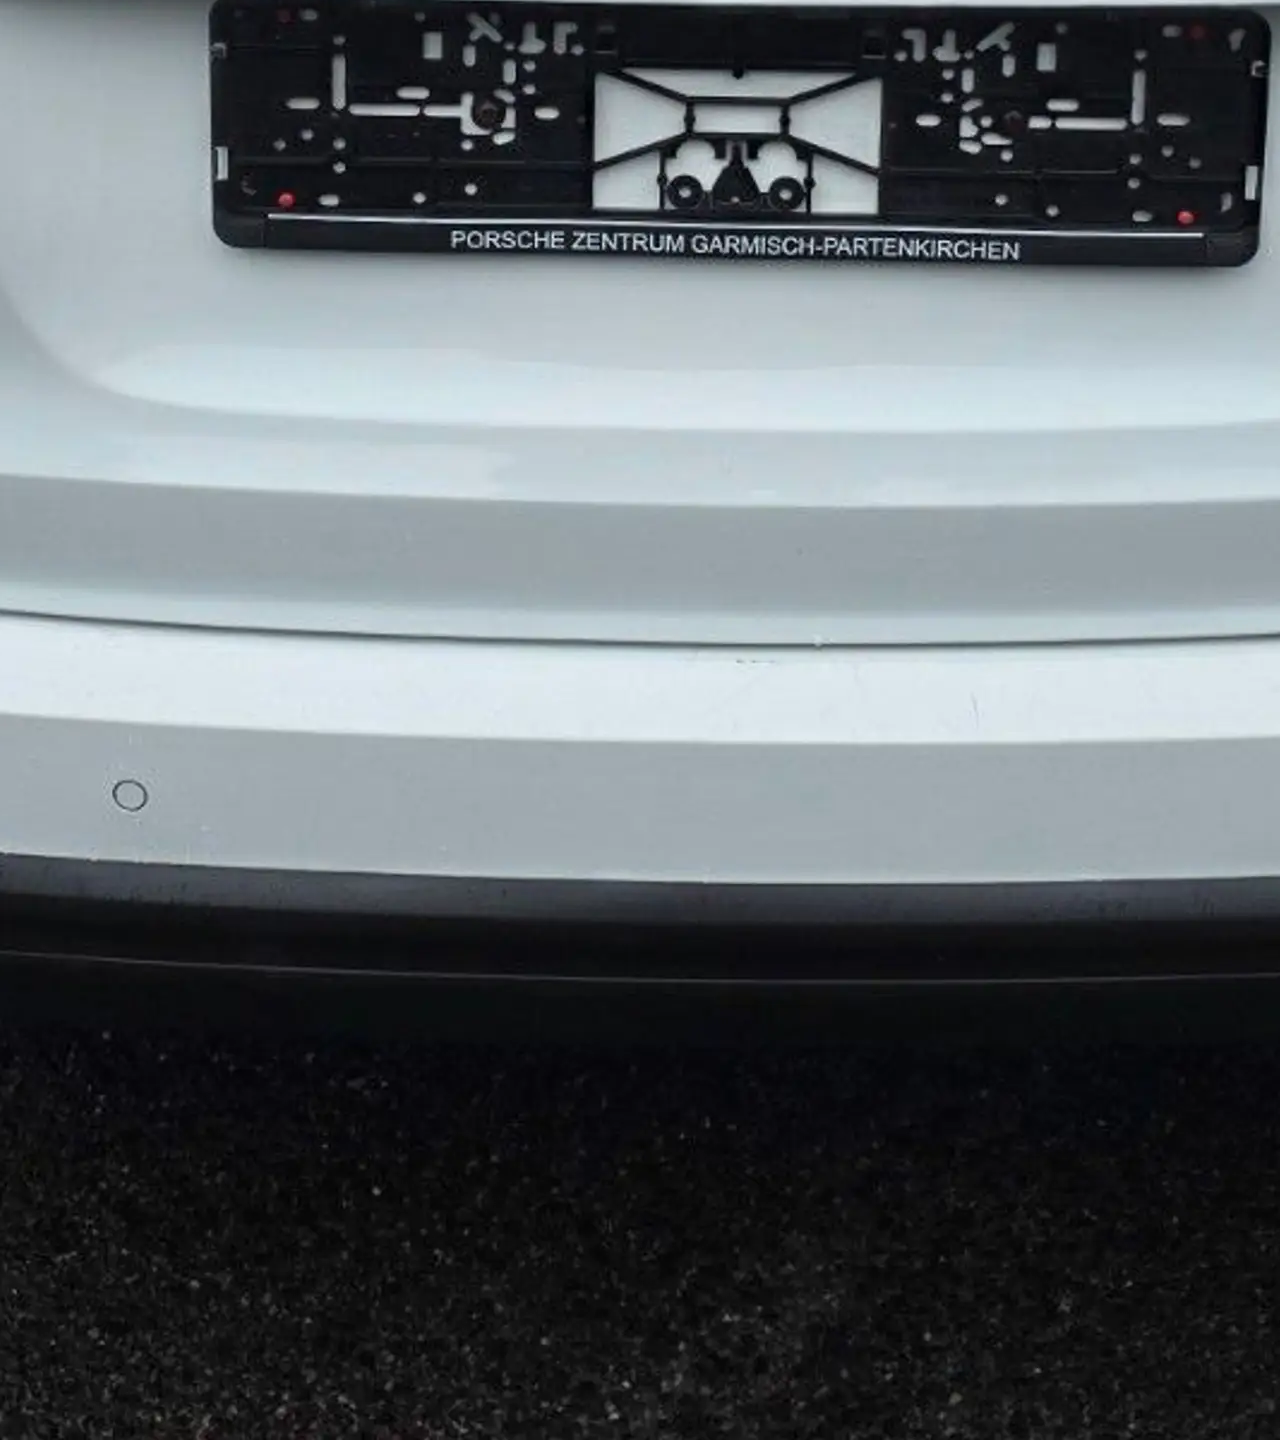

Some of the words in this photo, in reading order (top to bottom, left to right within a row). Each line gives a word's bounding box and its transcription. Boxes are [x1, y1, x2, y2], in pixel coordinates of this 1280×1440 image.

[450, 229, 566, 251] PORSCHE
[571, 231, 685, 254] ZENTRUM
[691, 234, 1020, 261] GARMISCH-PARTENKIRCHEN
